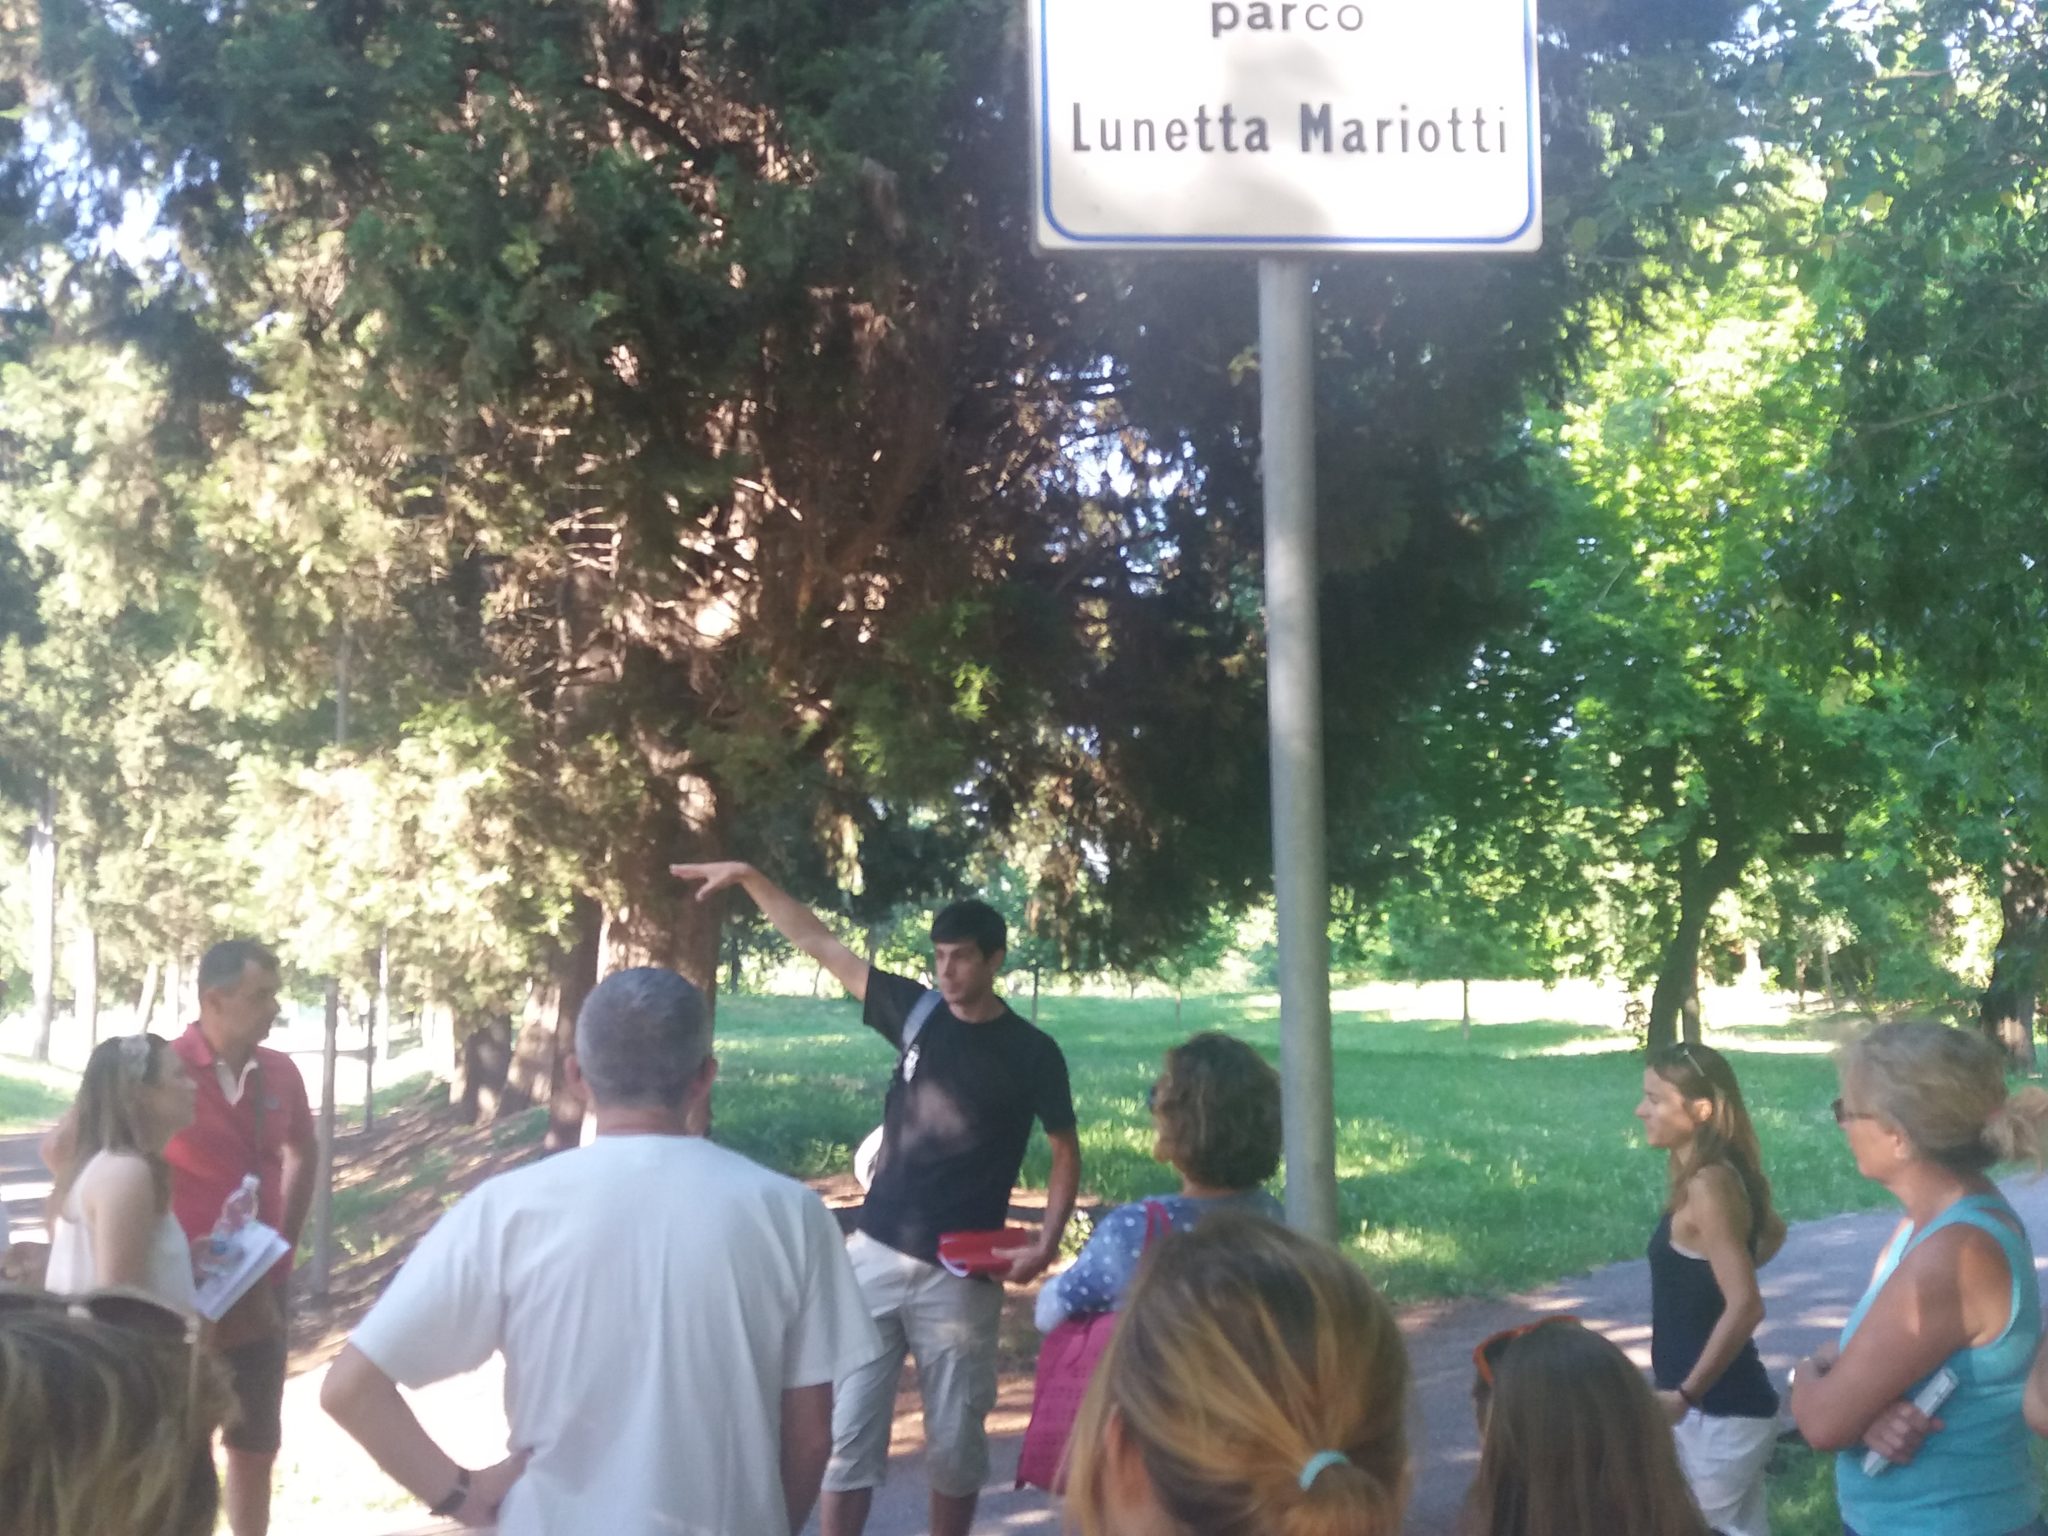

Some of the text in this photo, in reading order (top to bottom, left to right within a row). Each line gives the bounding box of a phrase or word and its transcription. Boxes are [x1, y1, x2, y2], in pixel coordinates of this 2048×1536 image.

[1211, 1, 1363, 38] parco
[1073, 102, 1508, 154] Lunetta Mariotti
